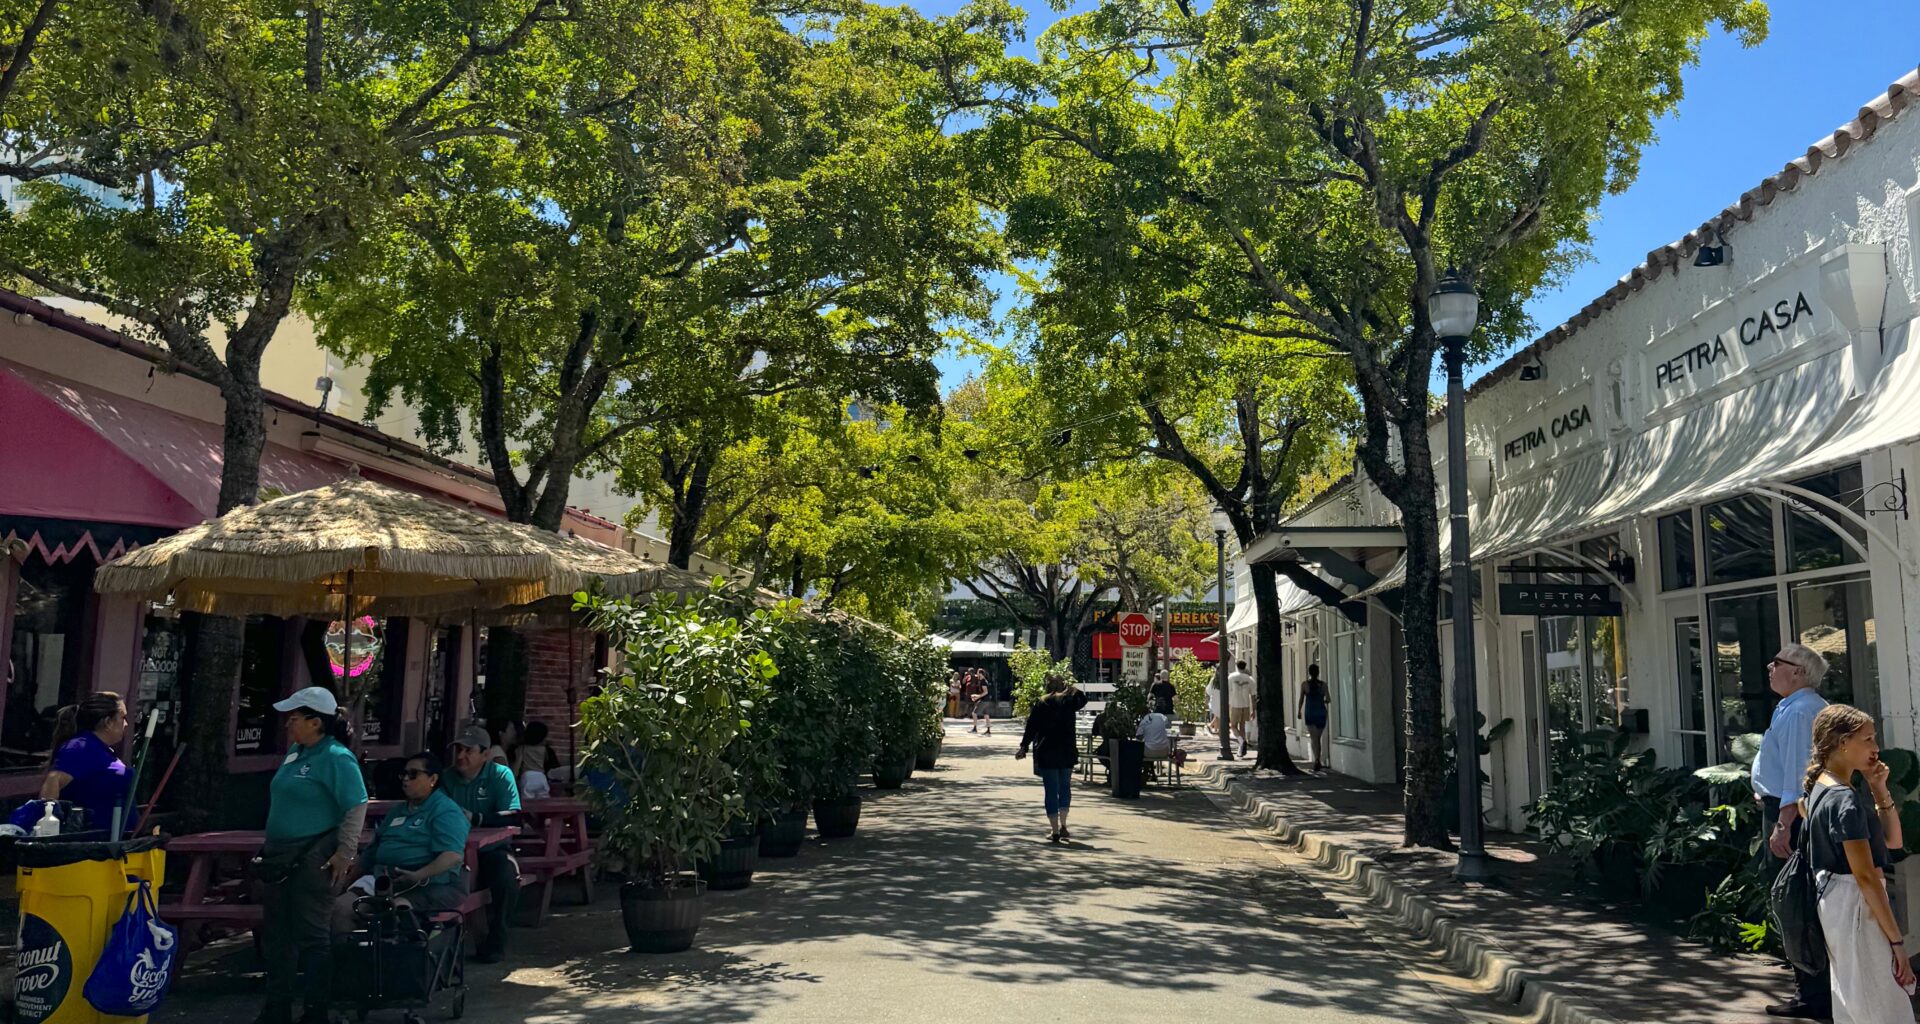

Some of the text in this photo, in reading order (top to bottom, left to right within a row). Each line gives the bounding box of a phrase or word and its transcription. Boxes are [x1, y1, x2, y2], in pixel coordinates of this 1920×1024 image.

[1740, 291, 1813, 345] CASA
[1551, 404, 1592, 438] CASA
[1519, 591, 1601, 601] PIETRA
[1121, 623, 1151, 637] STOP
[151, 646, 168, 659] NOT
[1126, 651, 1144, 659] RIGHT
[155, 660, 178, 673] DOOR
[1126, 668, 1141, 676] ONL
[236, 727, 262, 741] LUNCH
